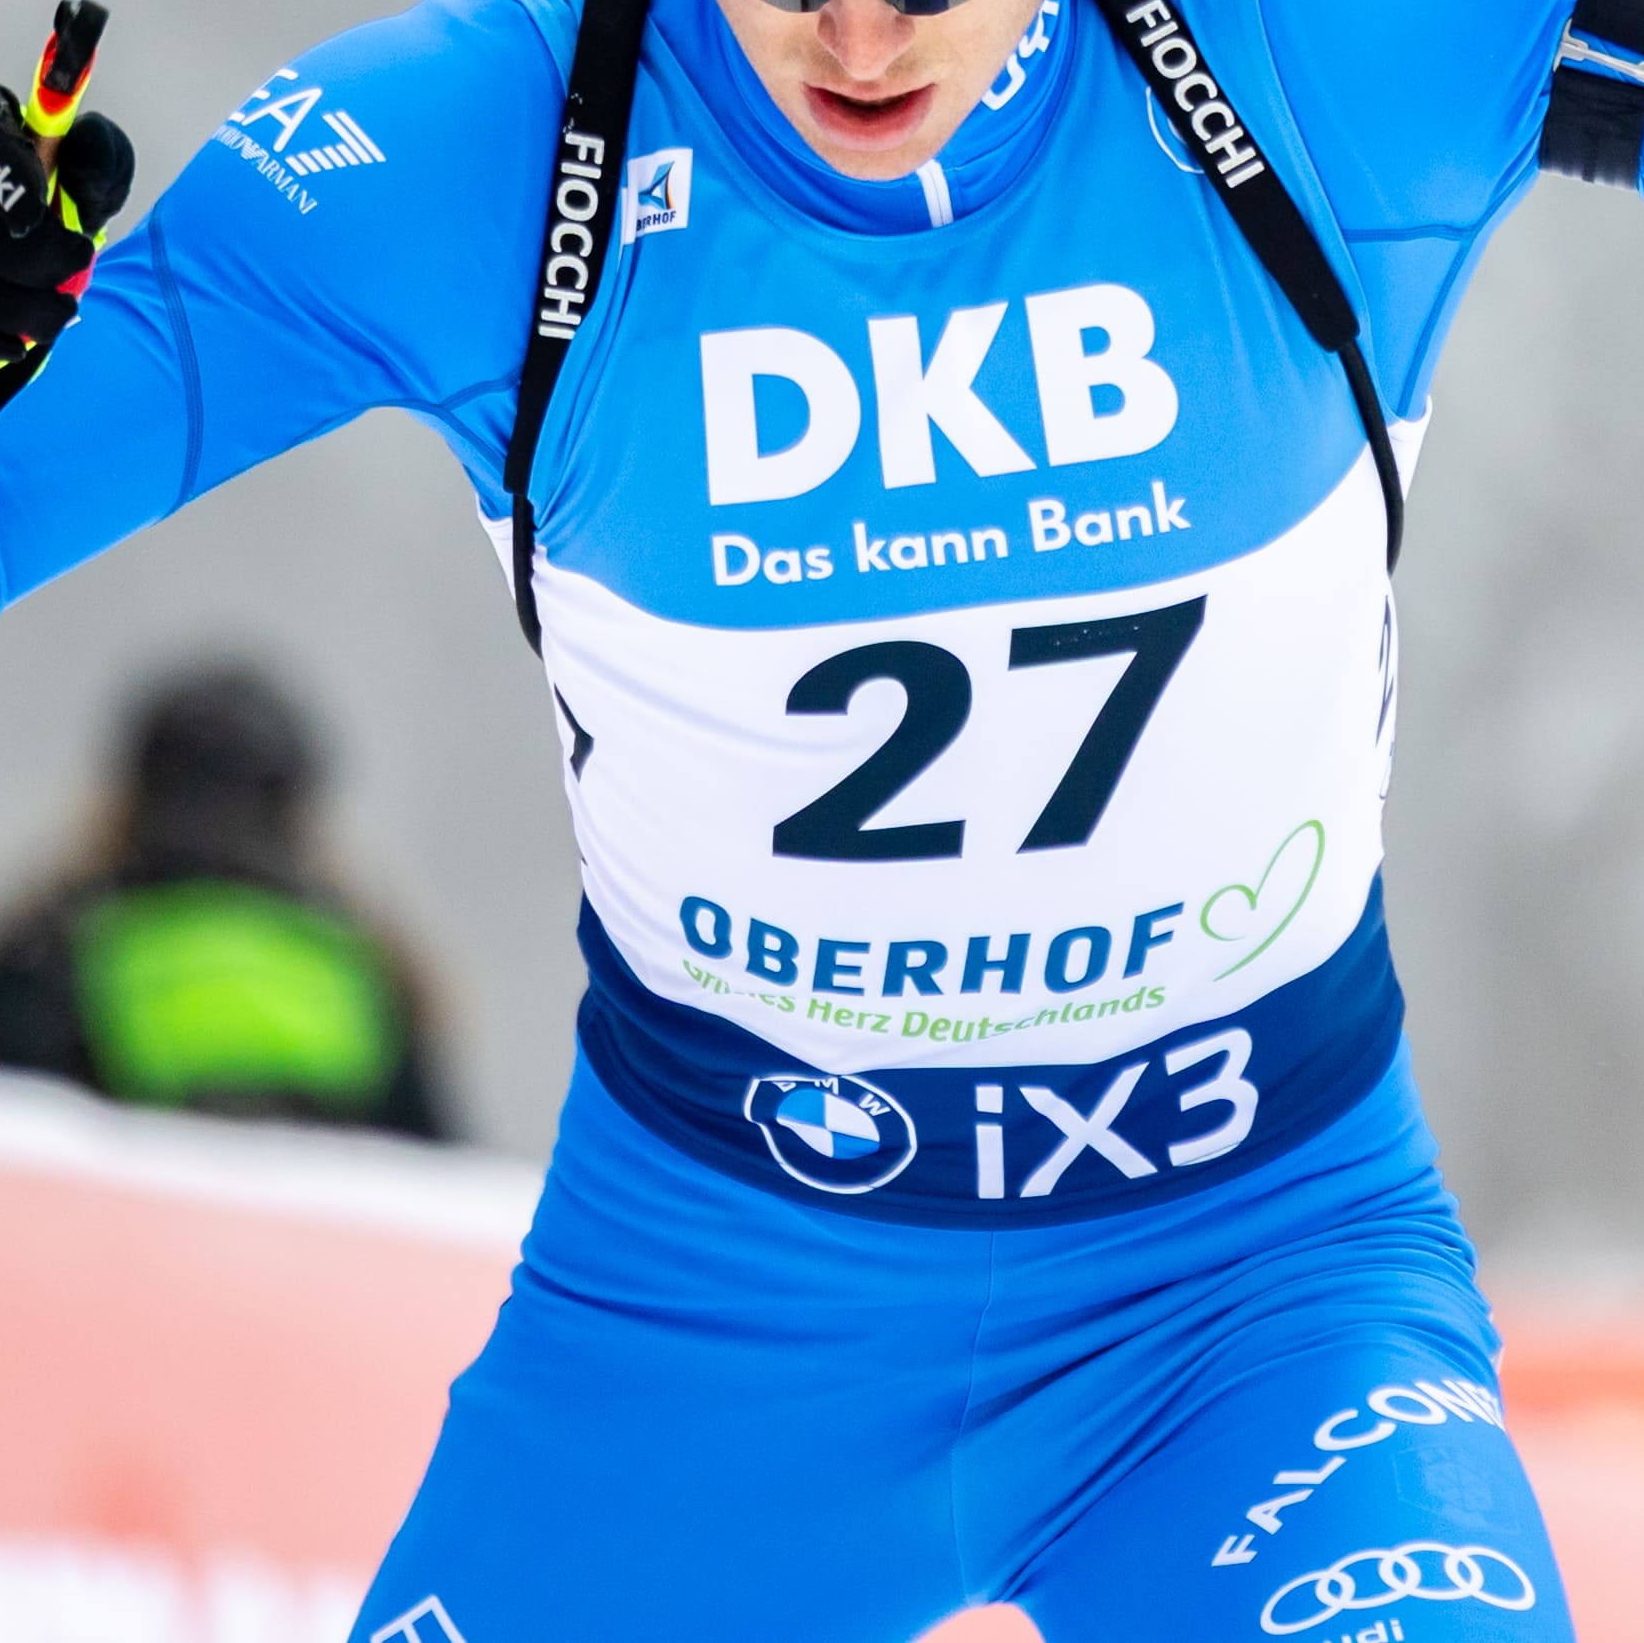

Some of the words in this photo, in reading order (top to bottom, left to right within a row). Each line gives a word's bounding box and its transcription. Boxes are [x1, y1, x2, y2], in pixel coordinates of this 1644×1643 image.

[538, 130, 605, 340] FIOCCHI
[700, 283, 1179, 506] DKB
[711, 534, 834, 586] Das
[852, 522, 1009, 573] kann
[1027, 480, 1192, 553] Bank
[772, 594, 1208, 861] 27
[680, 895, 1184, 997] OBERHOF
[807, 997, 892, 1034] Herz
[901, 985, 1168, 1043] Deutschlands
[974, 1027, 1258, 1200] iX3
